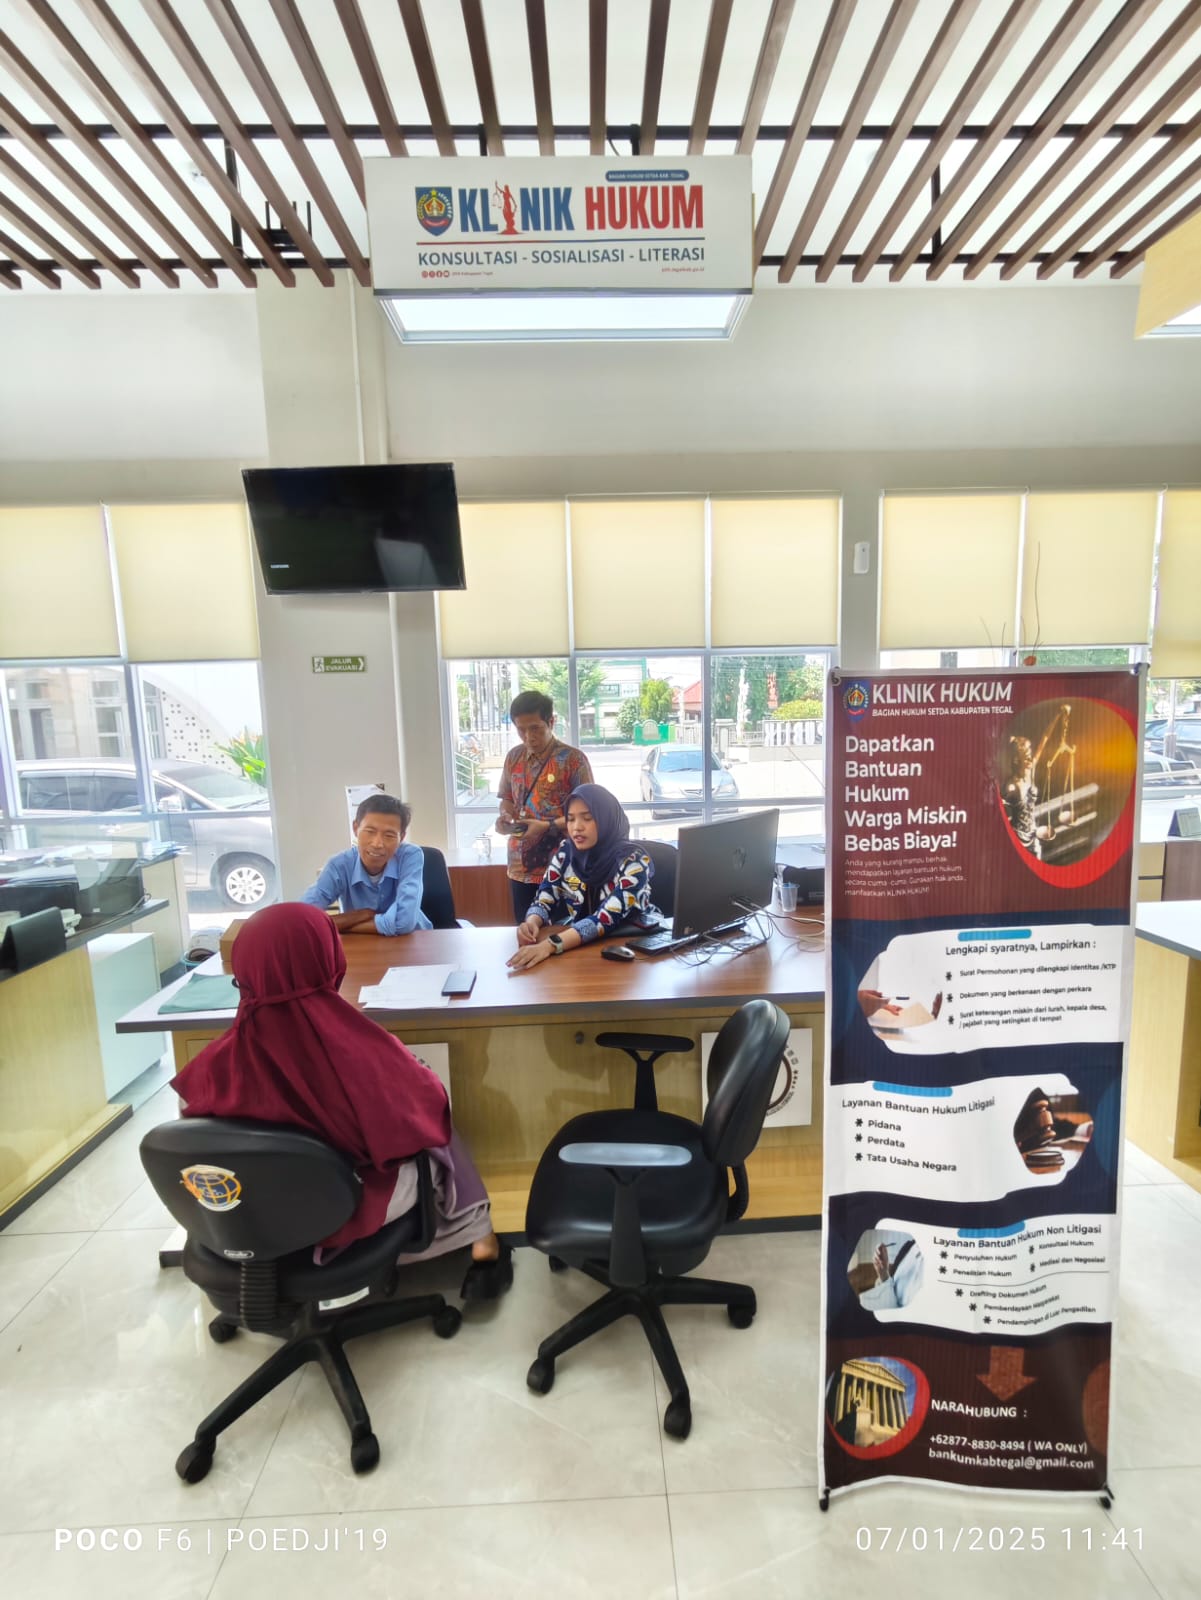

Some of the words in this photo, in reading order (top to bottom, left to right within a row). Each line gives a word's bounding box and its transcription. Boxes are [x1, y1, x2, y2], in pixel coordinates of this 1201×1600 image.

[585, 185, 704, 230] HUKUM
[418, 250, 518, 266] KONSULTASI
[531, 249, 625, 265] SOSIALISASI
[639, 247, 705, 262] LITERASI
[872, 683, 936, 704] KLINIK
[940, 682, 1013, 702] HUKUM
[872, 708, 900, 717] BAGIAN
[901, 708, 926, 716] HUKUM
[927, 708, 950, 716] SETDA
[950, 706, 990, 715] KABUPATEN
[991, 706, 1014, 714] TEGAL
[845, 734, 935, 757] Dapatkan
[845, 760, 922, 778] Bantuan
[845, 784, 909, 803] Hukum
[844, 810, 902, 830] Warga
[907, 806, 967, 825] Miskin
[844, 834, 900, 852] Bebas
[904, 830, 958, 853] Biaya!
[945, 943, 988, 958] Lengkapi
[990, 942, 1038, 954] syaratnya,
[1040, 939, 1091, 952] Lampirkan
[976, 968, 1018, 976] Permohonan
[1019, 966, 1035, 975] yang
[1036, 964, 1069, 974] dilengkapi
[960, 992, 989, 1000] Dokumen
[990, 991, 1006, 999] yang
[1008, 988, 1041, 997] berkenaan
[1042, 987, 1066, 996] dengan
[1067, 986, 1092, 995] perkara
[960, 1011, 974, 1019] Surat
[975, 1008, 1012, 1018] keterangan
[1012, 1006, 1034, 1014] miskin
[1034, 1006, 1047, 1014] dari
[1066, 1004, 1088, 1013] kepala
[1089, 1004, 1108, 1012] desa,
[984, 1018, 1000, 1026] yang
[1001, 1016, 1030, 1026] setingkat
[1032, 1015, 1038, 1023] di
[1039, 1014, 1062, 1024] tempat
[842, 1098, 882, 1110] Layanan
[886, 1100, 929, 1114] Bantuan
[932, 1106, 967, 1115] Hukum
[968, 1096, 996, 1112] Litigasi
[868, 1119, 902, 1132] Pidana
[867, 1136, 905, 1149] Perdata
[866, 1153, 887, 1164] Tata
[890, 1156, 920, 1168] Usaha
[922, 1160, 958, 1172] Negara
[933, 1236, 976, 1249] Layanan
[978, 1238, 1016, 1248] Bantuan
[1017, 1229, 1044, 1245] Hukum
[1046, 1226, 1064, 1236] Non
[1066, 1224, 1102, 1235] Litigasi
[1038, 1240, 1070, 1250] Konsultasi
[954, 1253, 994, 1262] Penyuluhan
[994, 1253, 1018, 1261] Hukum
[1061, 1256, 1073, 1264] dan
[1074, 1256, 1106, 1264] Negosiasi
[988, 1270, 1012, 1278] Hukum
[970, 1290, 997, 1299] Drafting
[998, 1290, 1029, 1299] Dokumen
[984, 1303, 1032, 1313] Pemberdayaan
[997, 1317, 1044, 1327] Pendampingan
[1050, 1310, 1060, 1319] Luar
[1061, 1306, 1096, 1315] Pengadilan
[931, 1399, 1018, 1418] NARAHUBUNG
[930, 1434, 1026, 1450] +62877-8830-8494
[1034, 1441, 1053, 1451] WA
[1055, 1442, 1088, 1454] ONLY)
[928, 1448, 1095, 1470] bankumkabtegal@gmail.com
